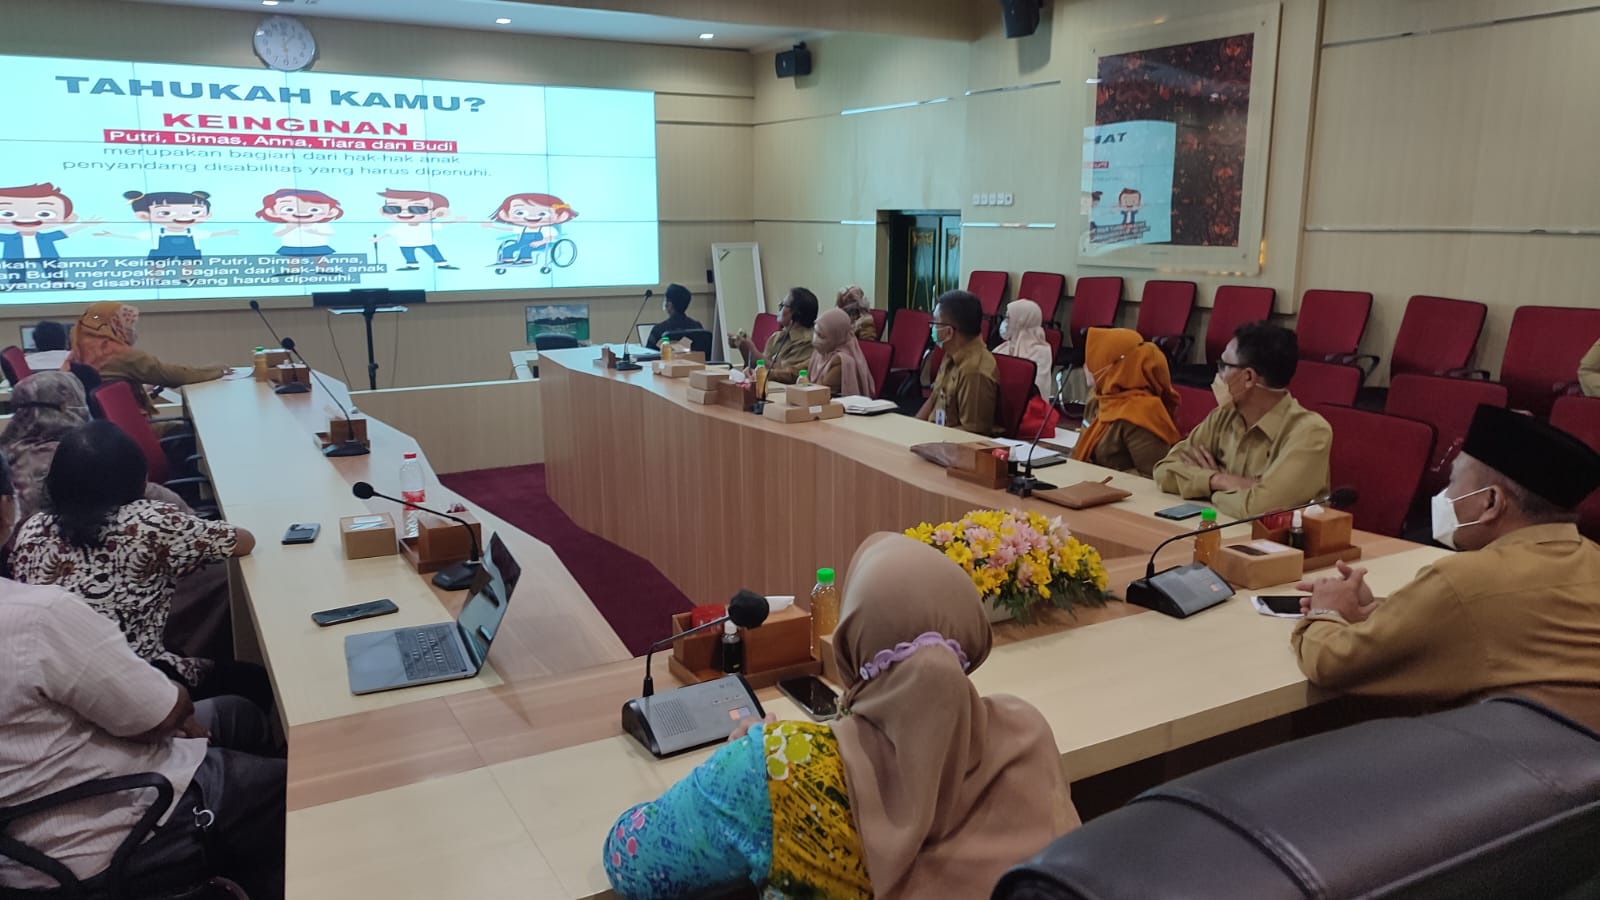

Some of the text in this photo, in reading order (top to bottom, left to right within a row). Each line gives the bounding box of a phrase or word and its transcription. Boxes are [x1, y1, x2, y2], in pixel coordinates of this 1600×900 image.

[55, 76, 486, 112] TAHUKAH KAMU?
[163, 113, 408, 136] KEINGINAN
[109, 131, 453, 152] Putri, Dimas, Anna, Tiara dan Budi
[103, 147, 460, 163] merupakan bagian dari hak-hak anak
[63, 161, 492, 177] penyandang disabilitas yang harus dipenuhi.
[43, 260, 108, 268] Kamu?
[115, 258, 203, 268] Keinginan
[209, 257, 252, 266] Putri,
[258, 256, 314, 266] Dimas,
[318, 256, 363, 265] Anna,
[26, 270, 69, 279] Budi
[75, 270, 176, 279] merupakan
[182, 268, 239, 278] bagian
[244, 266, 275, 275] dari
[281, 266, 342, 275] hak-hak
[348, 265, 385, 273] anak
[92, 279, 181, 288] disabilitas
[186, 278, 228, 287] yang
[234, 275, 279, 284] harus
